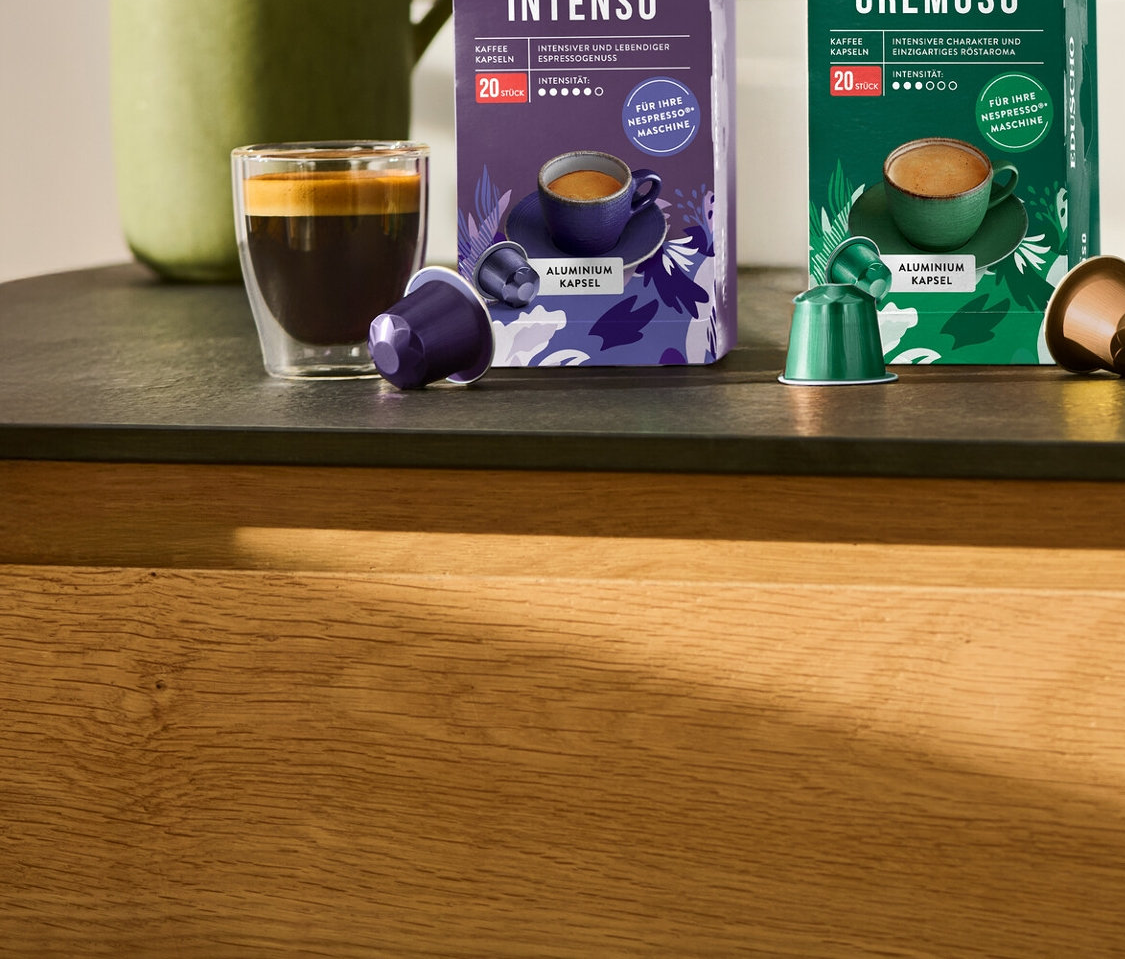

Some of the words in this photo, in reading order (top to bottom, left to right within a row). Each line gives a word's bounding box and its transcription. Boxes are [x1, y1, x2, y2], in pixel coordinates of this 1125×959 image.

[475, 45, 508, 53] KAFFEE
[538, 44, 589, 52] INTENSIVER
[615, 43, 670, 51] LEBENDIGER
[831, 48, 869, 56] KAPSELN
[892, 48, 958, 56] EINZIGARTIGES
[961, 46, 1016, 56] RÖSTAROMA
[476, 55, 514, 63] KAPSELN
[538, 54, 618, 62] ESPRESSOGENUSS
[893, 69, 943, 78] INTENSITÄT:
[538, 75, 590, 84] INTENSITÄT:
[834, 71, 854, 91] 20
[855, 81, 878, 90] STÜCK
[479, 78, 499, 98] 20
[500, 88, 525, 97] STÜCK
[989, 96, 1009, 107] FÜR
[1012, 92, 1036, 104] IHRE
[636, 101, 656, 113] FÜR
[658, 96, 683, 109] IHRE
[637, 120, 690, 137] MASCHINE
[990, 116, 1043, 132] MASCHINE
[547, 266, 612, 275] ALUMINIUM
[899, 263, 964, 272] ALUMINIUM
[560, 279, 600, 288] KAPSEL
[911, 276, 952, 285] KAPSEL
